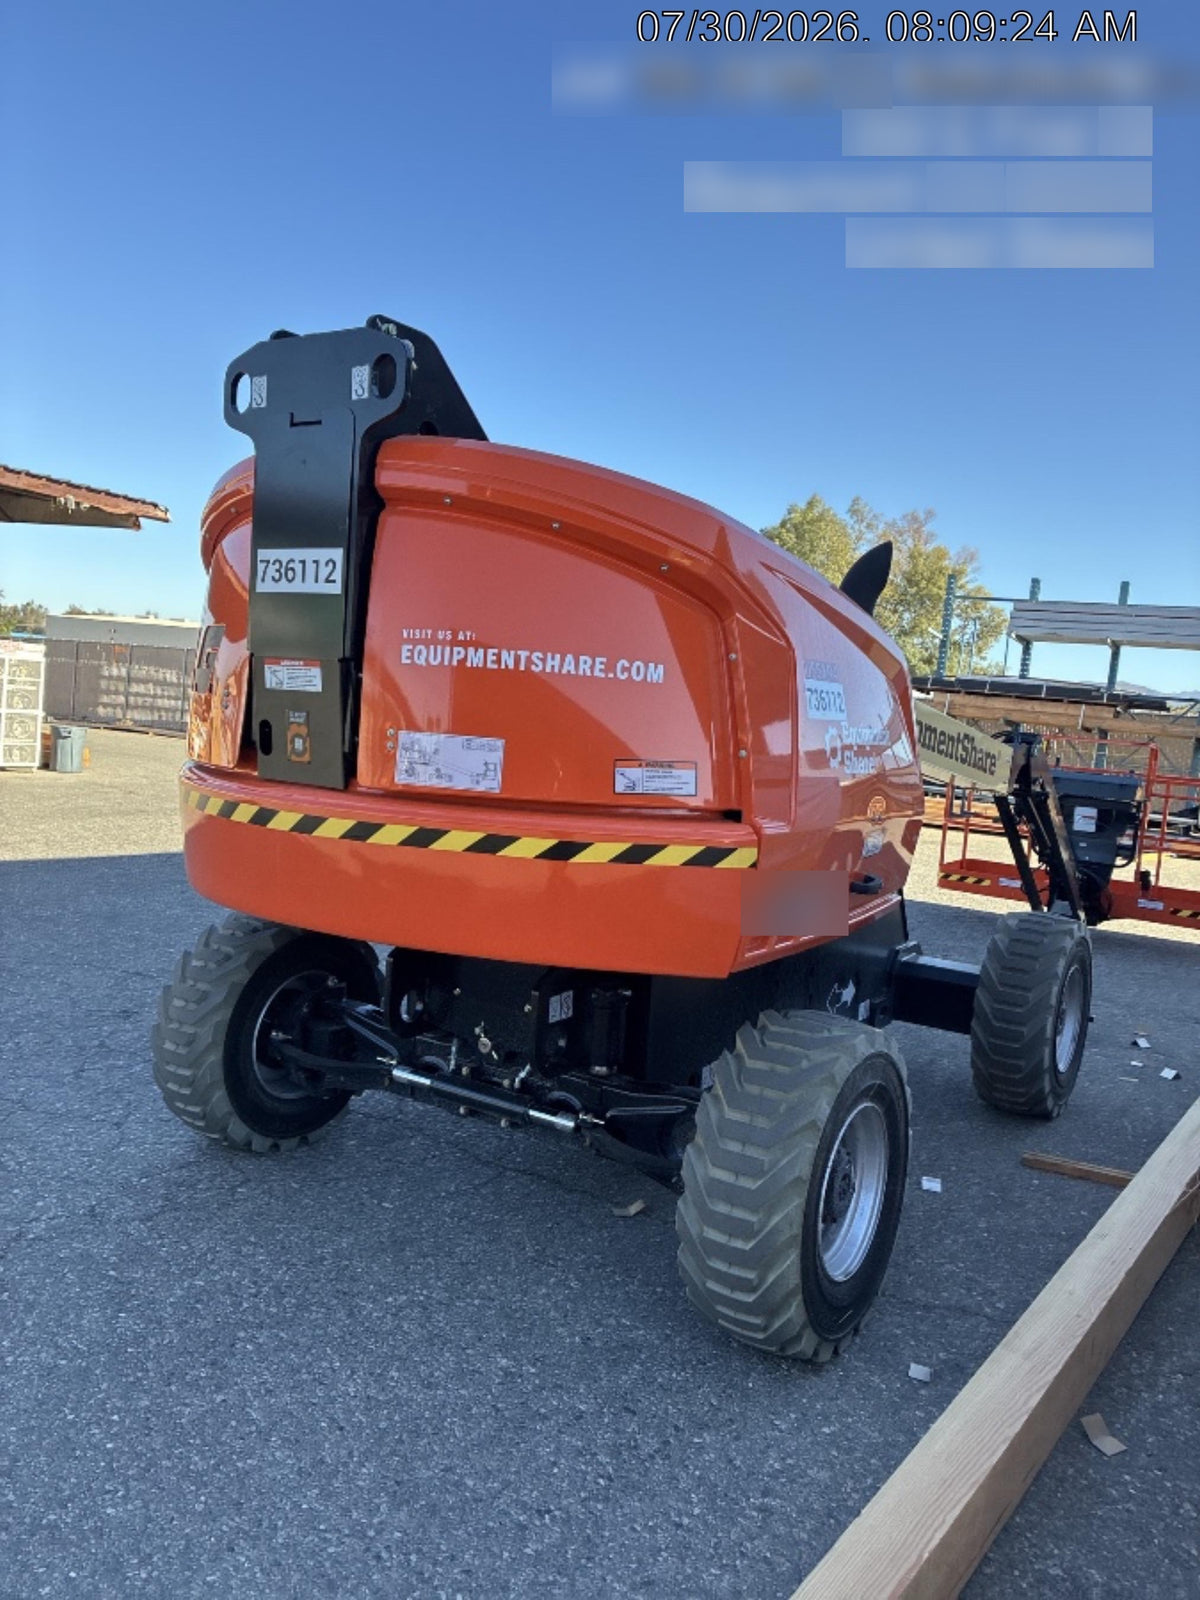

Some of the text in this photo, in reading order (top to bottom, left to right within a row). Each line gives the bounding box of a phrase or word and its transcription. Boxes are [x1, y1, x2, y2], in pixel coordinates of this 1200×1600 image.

[259, 558, 337, 585] 736112
[402, 628, 476, 641] VISIT US AT:
[401, 644, 665, 684] EQUIPMENTSHARE.COM
